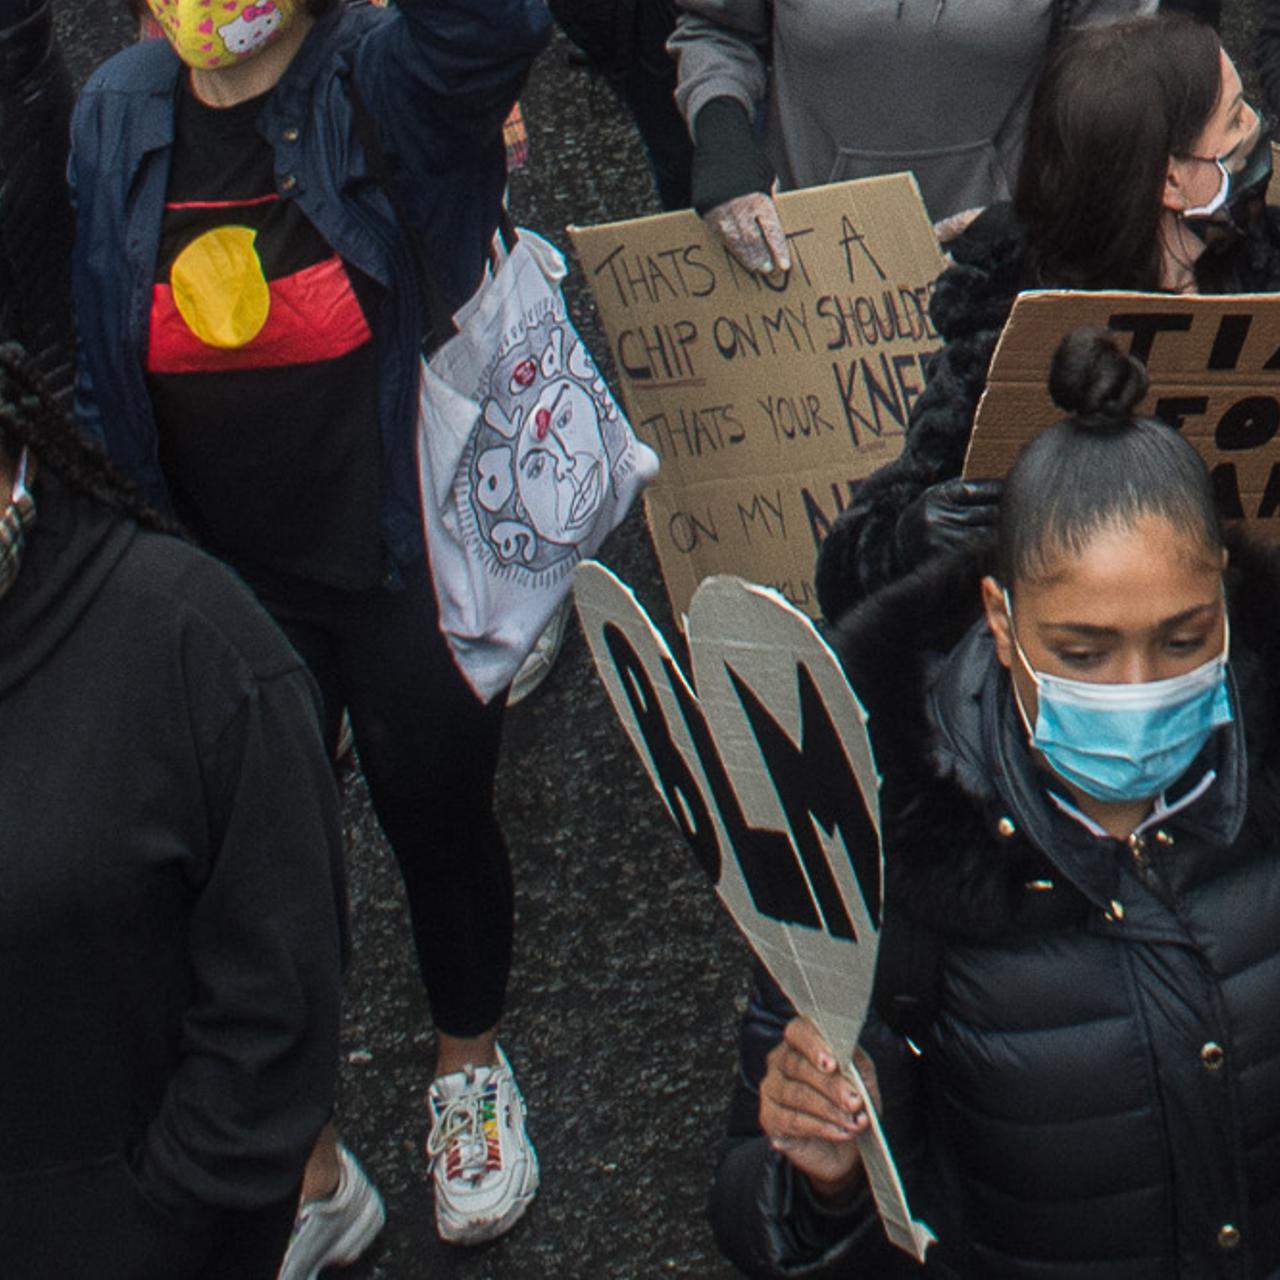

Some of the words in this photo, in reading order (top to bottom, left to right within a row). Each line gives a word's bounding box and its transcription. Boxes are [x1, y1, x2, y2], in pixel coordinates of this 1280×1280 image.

[594, 243, 716, 307] THATS
[839, 214, 886, 283] A
[617, 319, 698, 380] CHIP
[713, 311, 761, 361] ON
[762, 303, 817, 354] MY
[641, 403, 746, 459] THATS
[758, 394, 834, 440] YOUR
[669, 510, 720, 554] ON
[738, 489, 790, 545] MY
